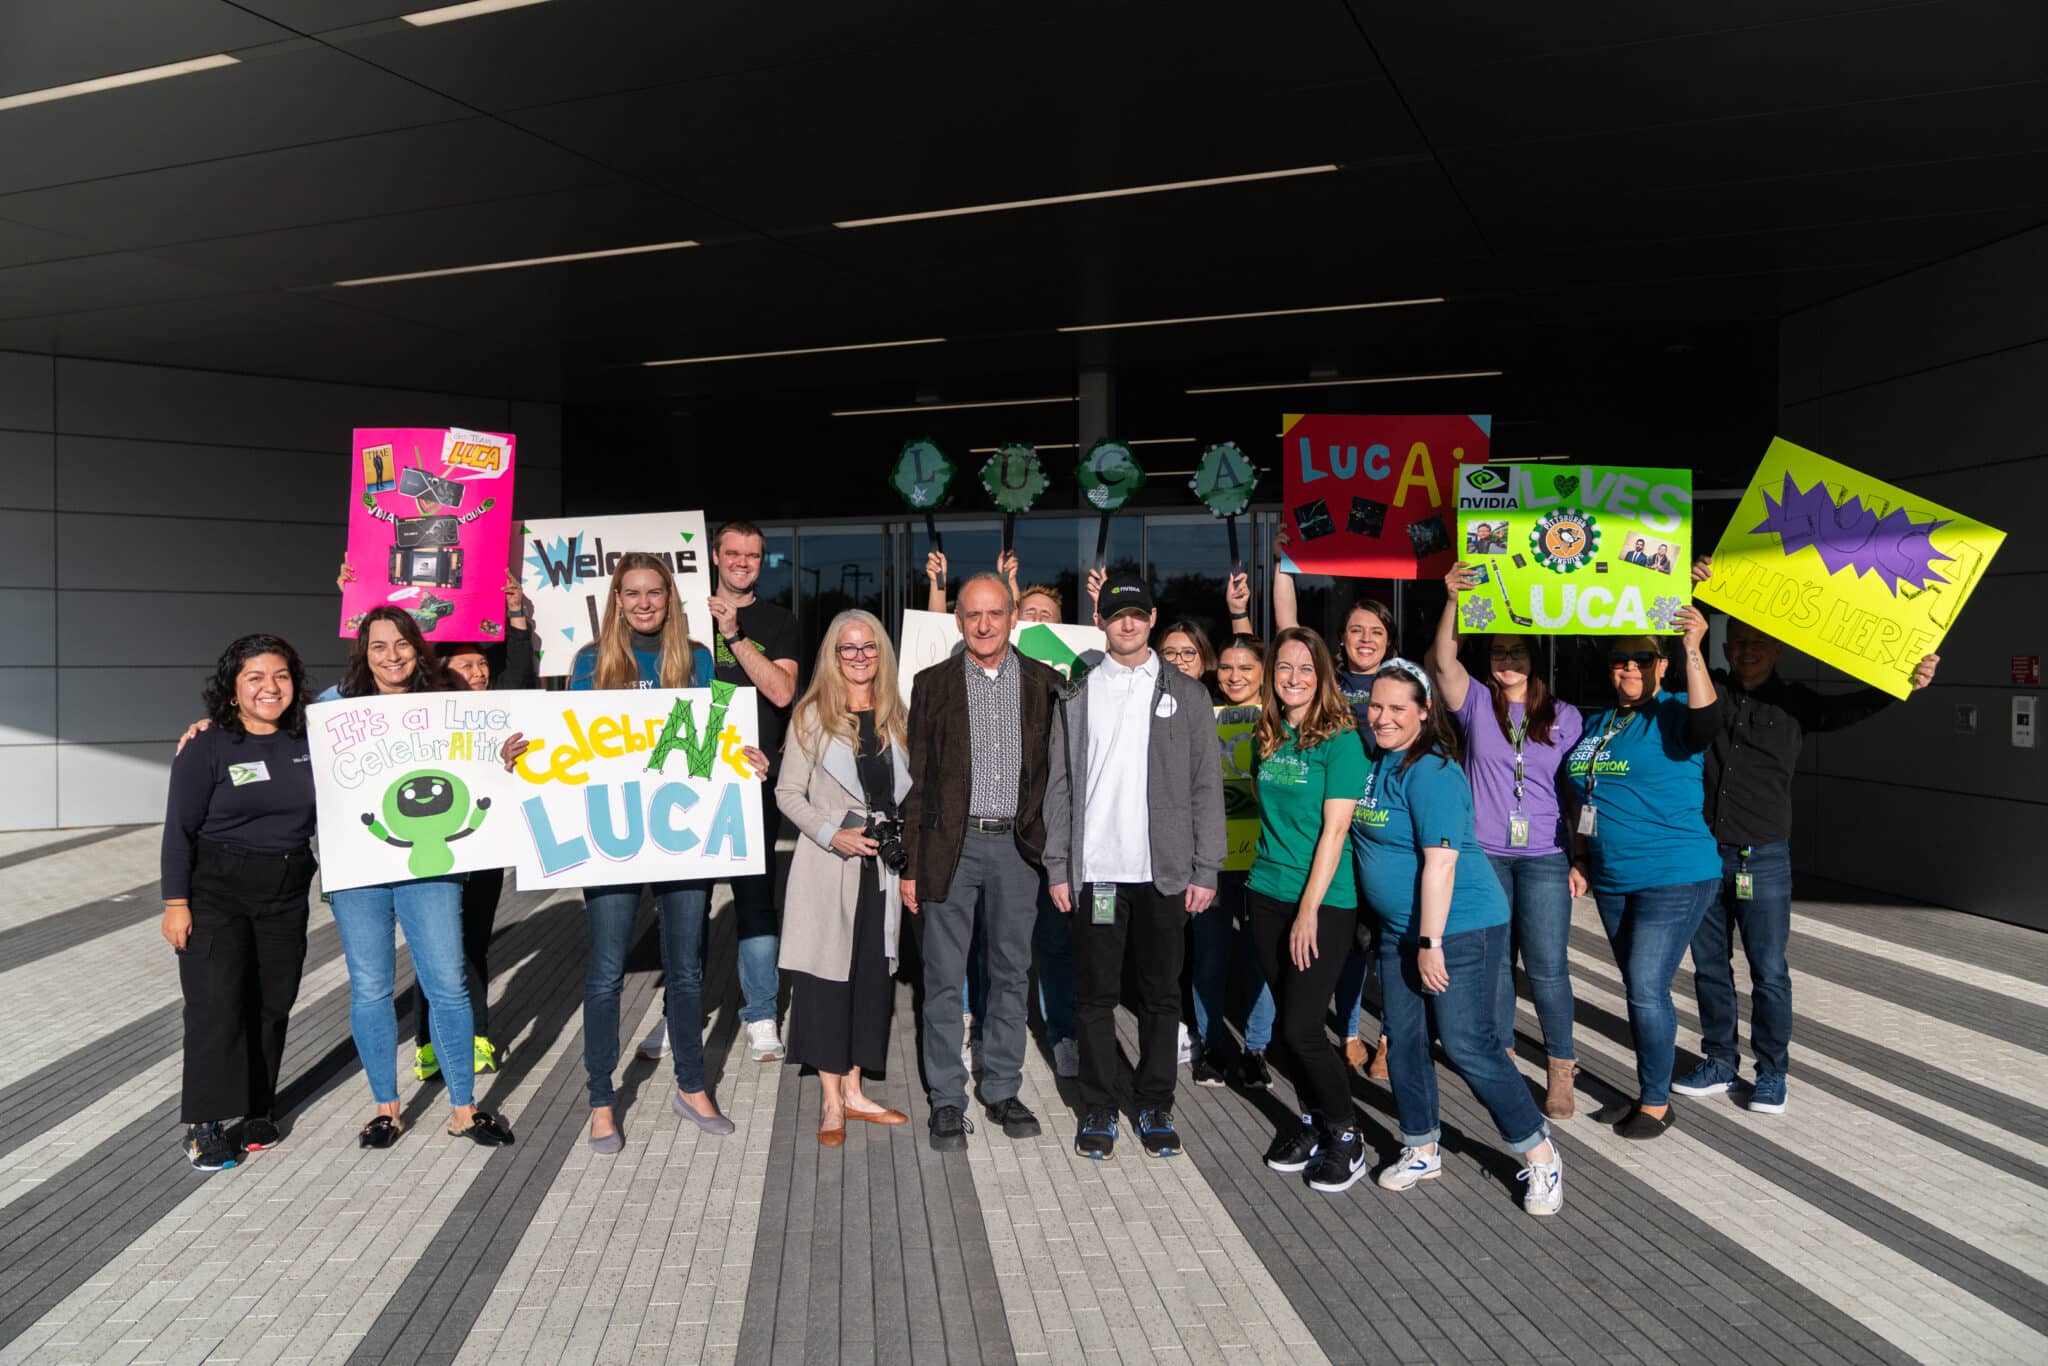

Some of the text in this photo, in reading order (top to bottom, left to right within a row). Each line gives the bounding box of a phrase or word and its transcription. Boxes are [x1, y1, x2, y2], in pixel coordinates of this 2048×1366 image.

[448, 441, 501, 471] LUCA
[1543, 514, 1587, 530] PITTSBURGH
[533, 536, 697, 588] Welce
[1818, 598, 1937, 678] HERE
[325, 699, 512, 755] It's a Luc
[1569, 760, 1631, 772] CHAPION.
[519, 780, 749, 878] LUCA
